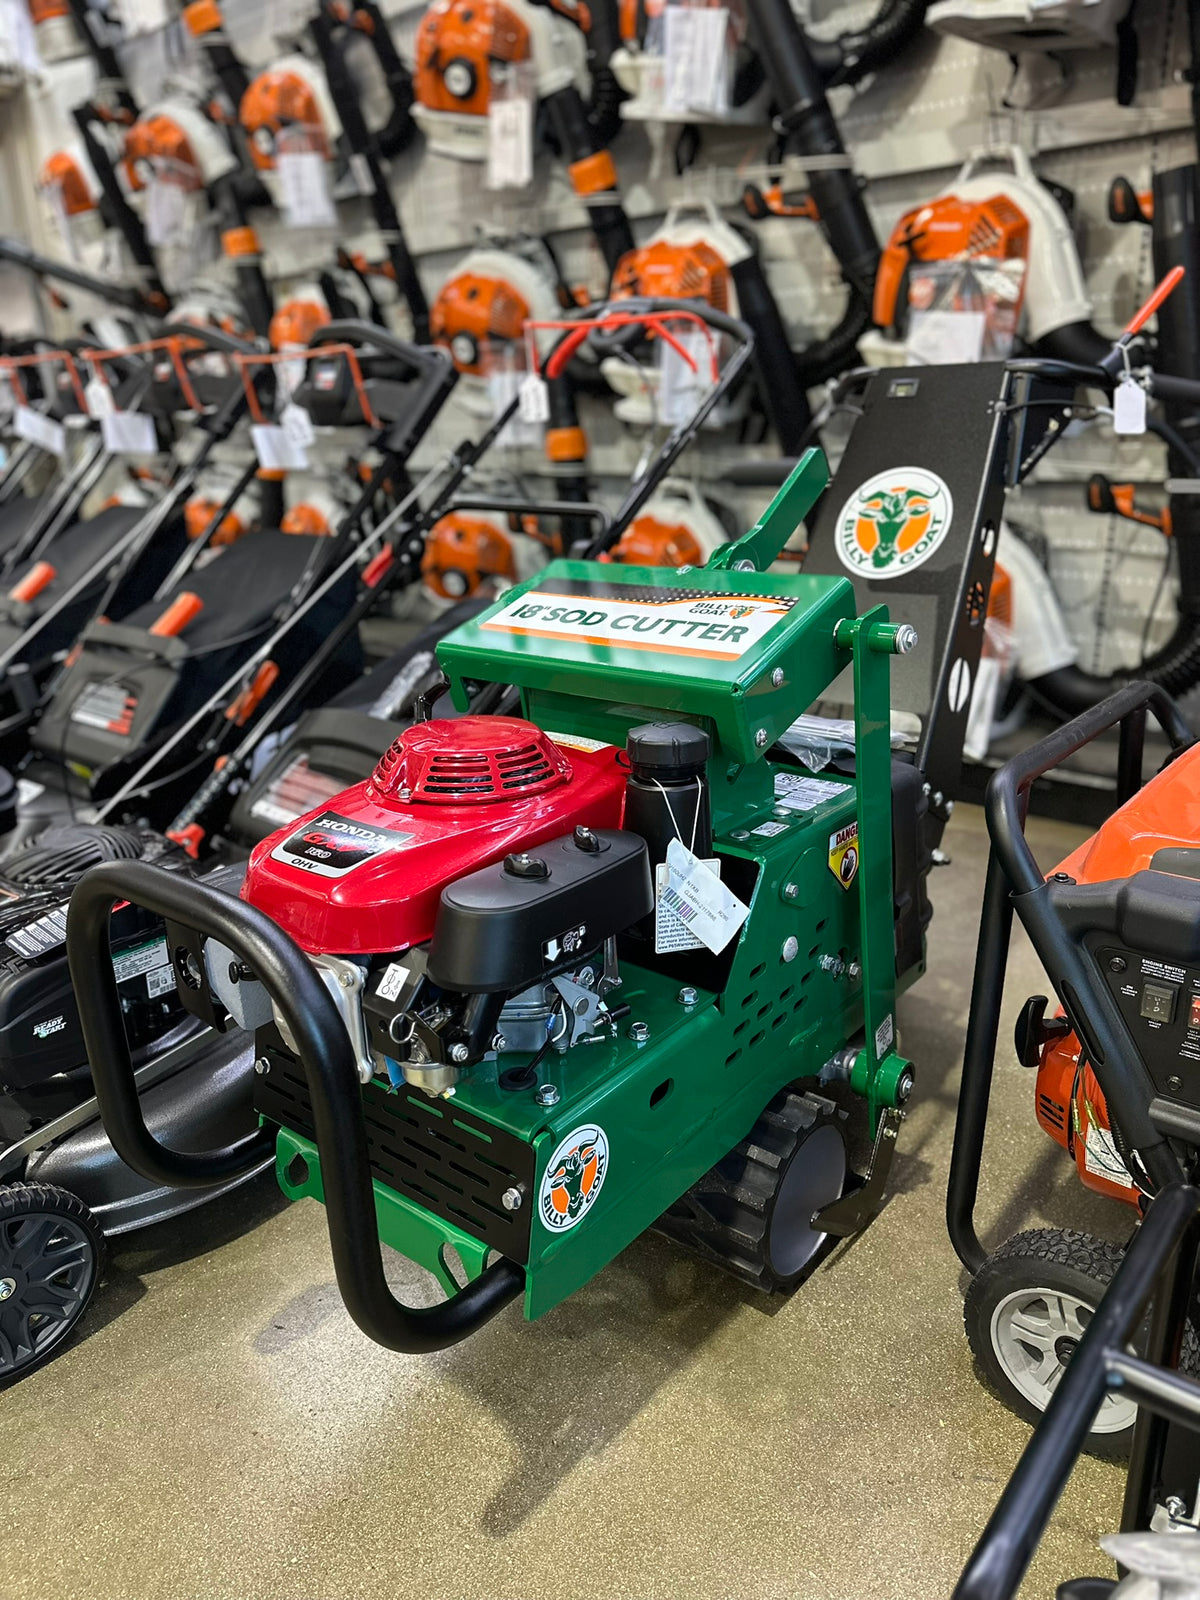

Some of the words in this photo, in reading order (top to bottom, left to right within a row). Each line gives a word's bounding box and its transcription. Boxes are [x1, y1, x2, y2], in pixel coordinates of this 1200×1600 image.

[844, 519, 869, 565] BILLY
[900, 513, 942, 565] GOAT
[689, 608, 728, 616] GOAT
[694, 602, 733, 610] BILLY
[610, 615, 750, 643] CUTTER
[315, 819, 387, 842] HONDA
[291, 858, 319, 870] OHV
[1164, 964, 1187, 975] SWITCH
[543, 1193, 568, 1226] BILLY
[585, 1151, 605, 1204] GOAT
